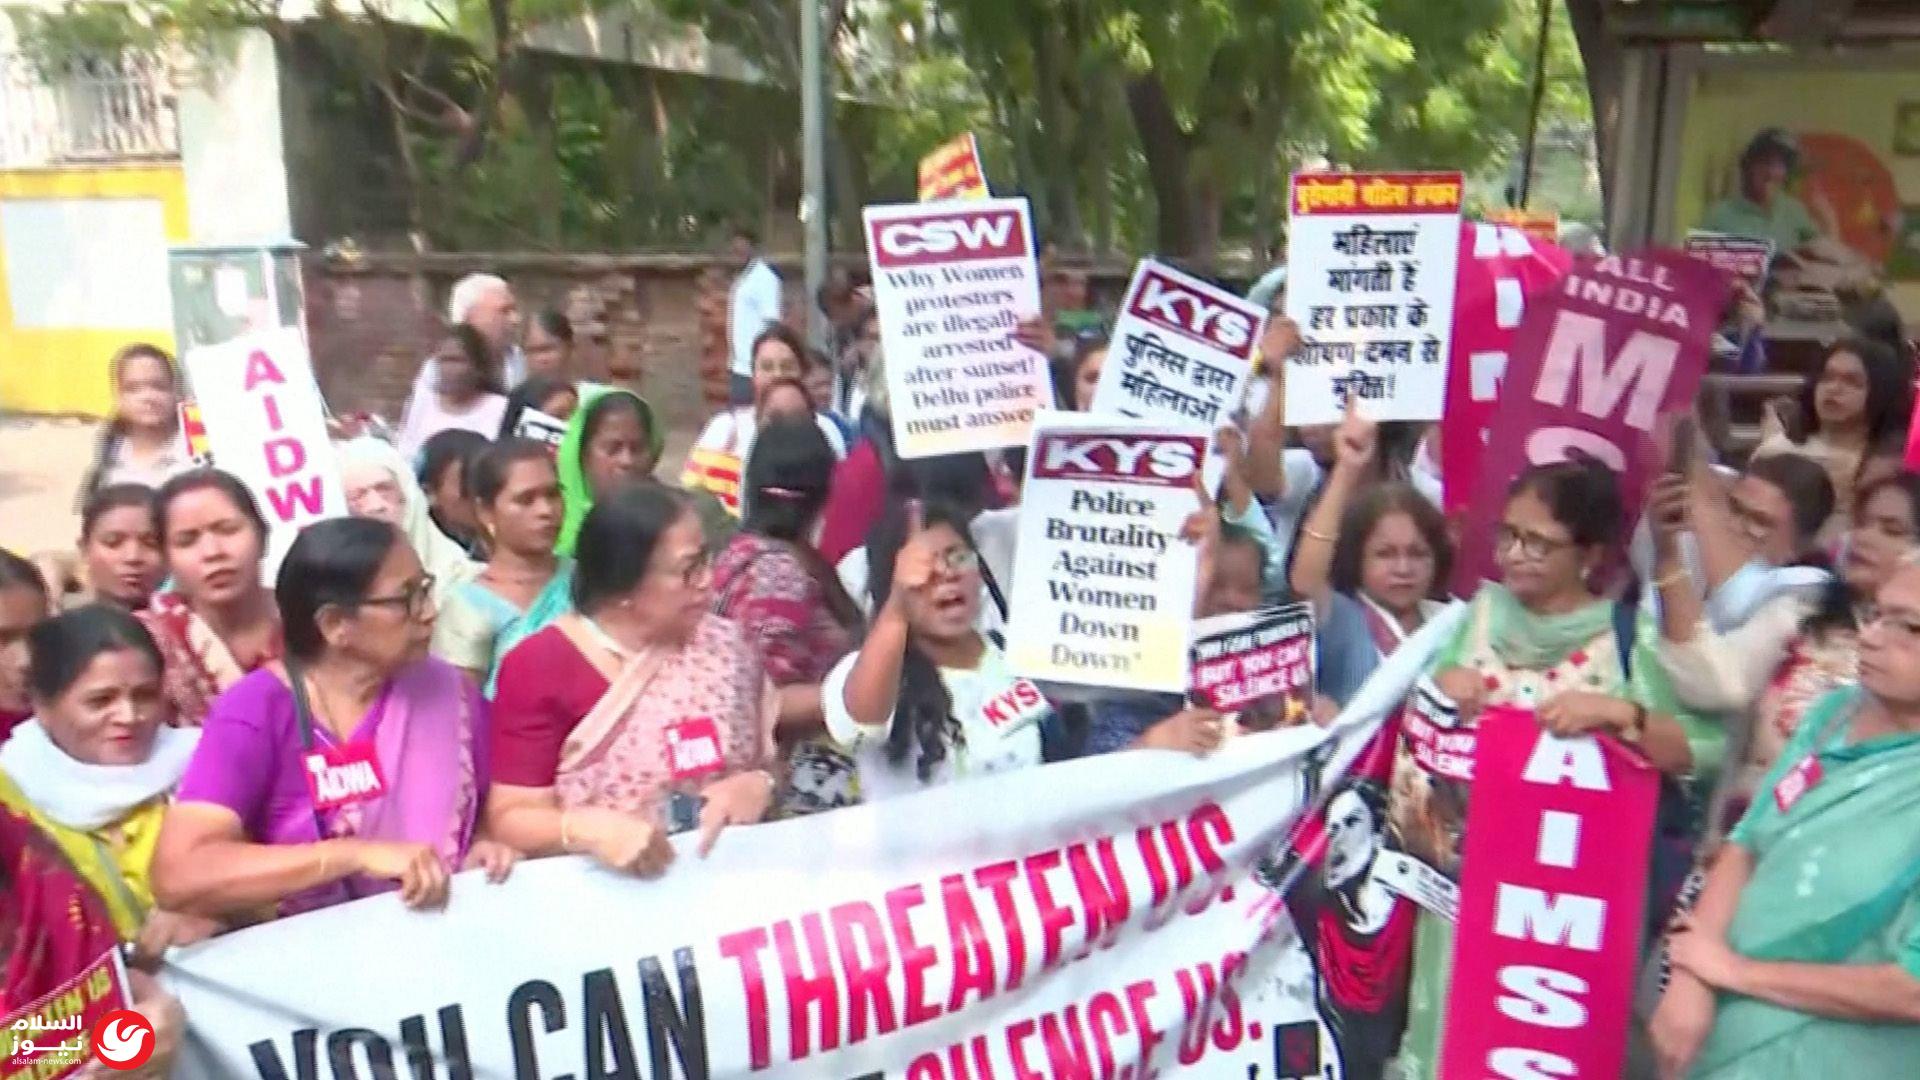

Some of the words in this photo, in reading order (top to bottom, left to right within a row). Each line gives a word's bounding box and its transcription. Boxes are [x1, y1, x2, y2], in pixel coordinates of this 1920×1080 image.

[880, 216, 1013, 257] CSW
[887, 269, 935, 289] Why
[941, 264, 1025, 284] Women
[1595, 256, 1676, 292] ALL
[905, 290, 1016, 317] protesters
[1139, 279, 1251, 347] KYS
[1565, 275, 1689, 329] INDIA
[903, 321, 936, 338] are
[923, 335, 1014, 359] arrested
[1122, 332, 1190, 375] पुलिस
[904, 365, 957, 385] after
[963, 356, 1035, 377] sunset!
[913, 386, 970, 409] Delhi
[975, 383, 1035, 407] police
[1121, 370, 1223, 424] महिलाओं
[906, 414, 961, 435] must
[965, 408, 1036, 429] answe
[1043, 439, 1199, 479] KYS
[1070, 489, 1157, 517] Police
[1046, 517, 1169, 555] Brutality
[1053, 551, 1159, 581] Against
[1048, 580, 1158, 612] Women
[1060, 612, 1140, 642] Down
[982, 682, 1039, 727] KYS
[505, 946, 709, 1080] CAN
[719, 836, 1132, 1072] THREATEN
[1176, 950, 1264, 1066] US.
